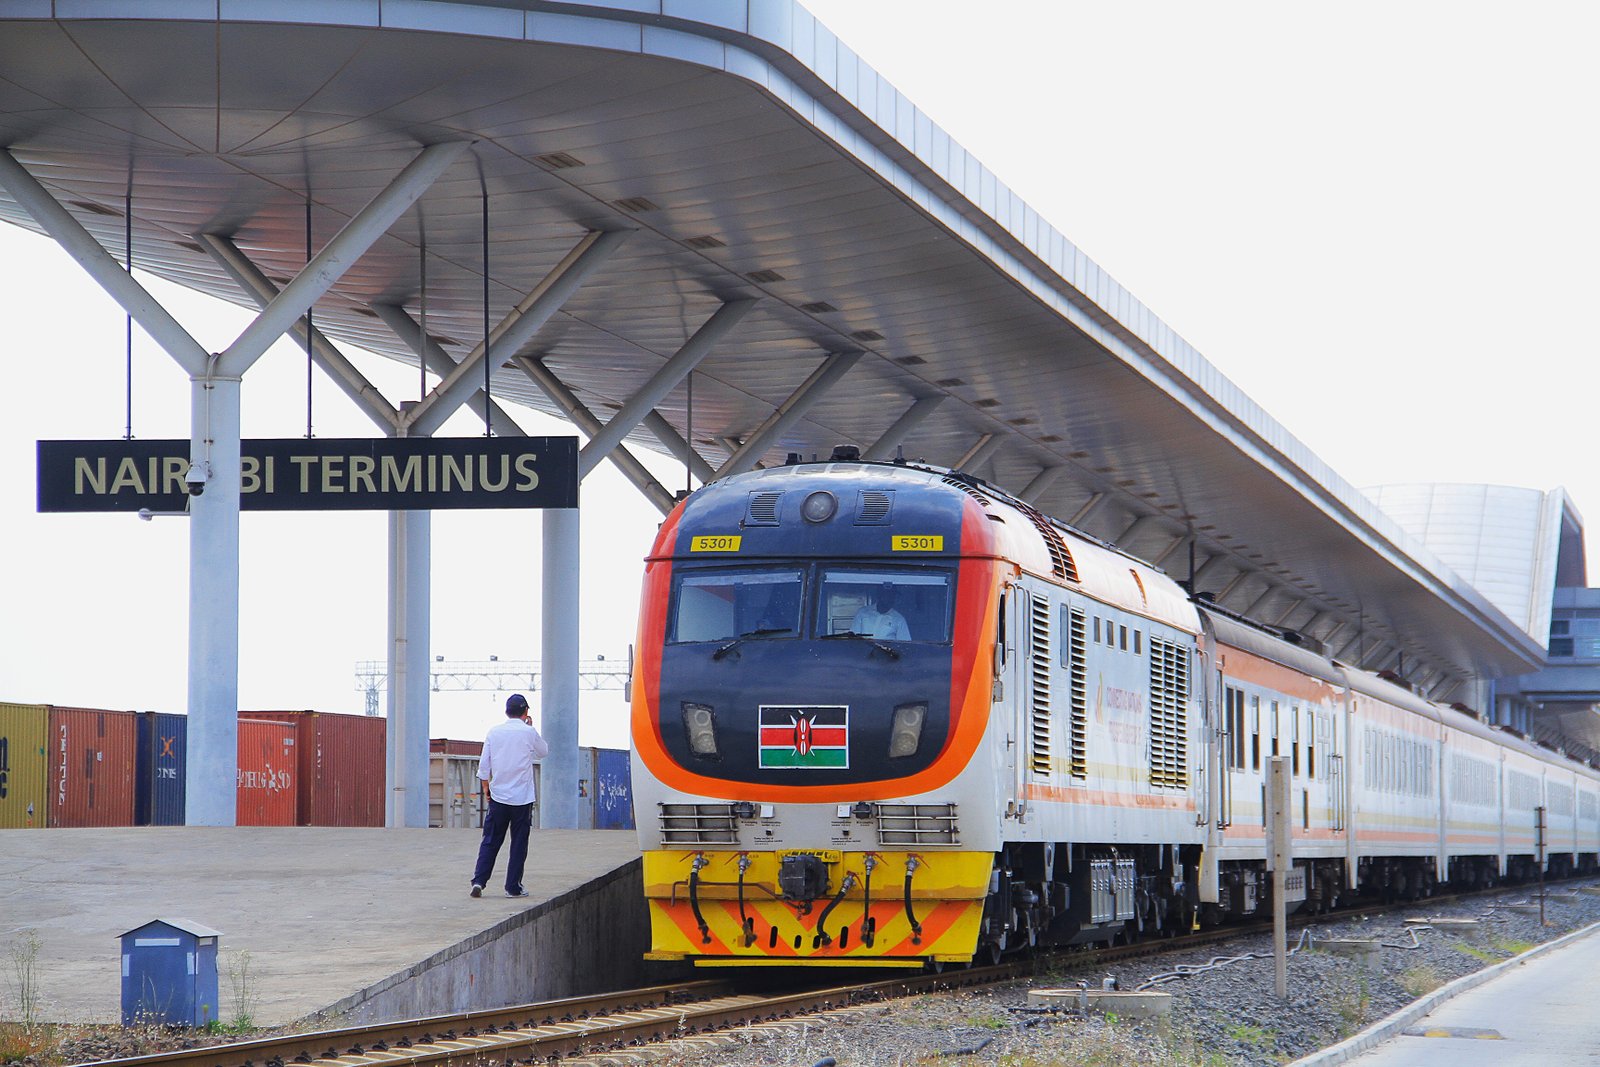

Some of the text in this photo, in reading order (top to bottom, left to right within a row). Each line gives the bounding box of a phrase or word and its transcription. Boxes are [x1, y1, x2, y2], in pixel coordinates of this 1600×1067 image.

[74, 453, 539, 495] NAIRBI TERMINUS
[700, 538, 733, 549] 5301
[900, 537, 934, 549] 5301
